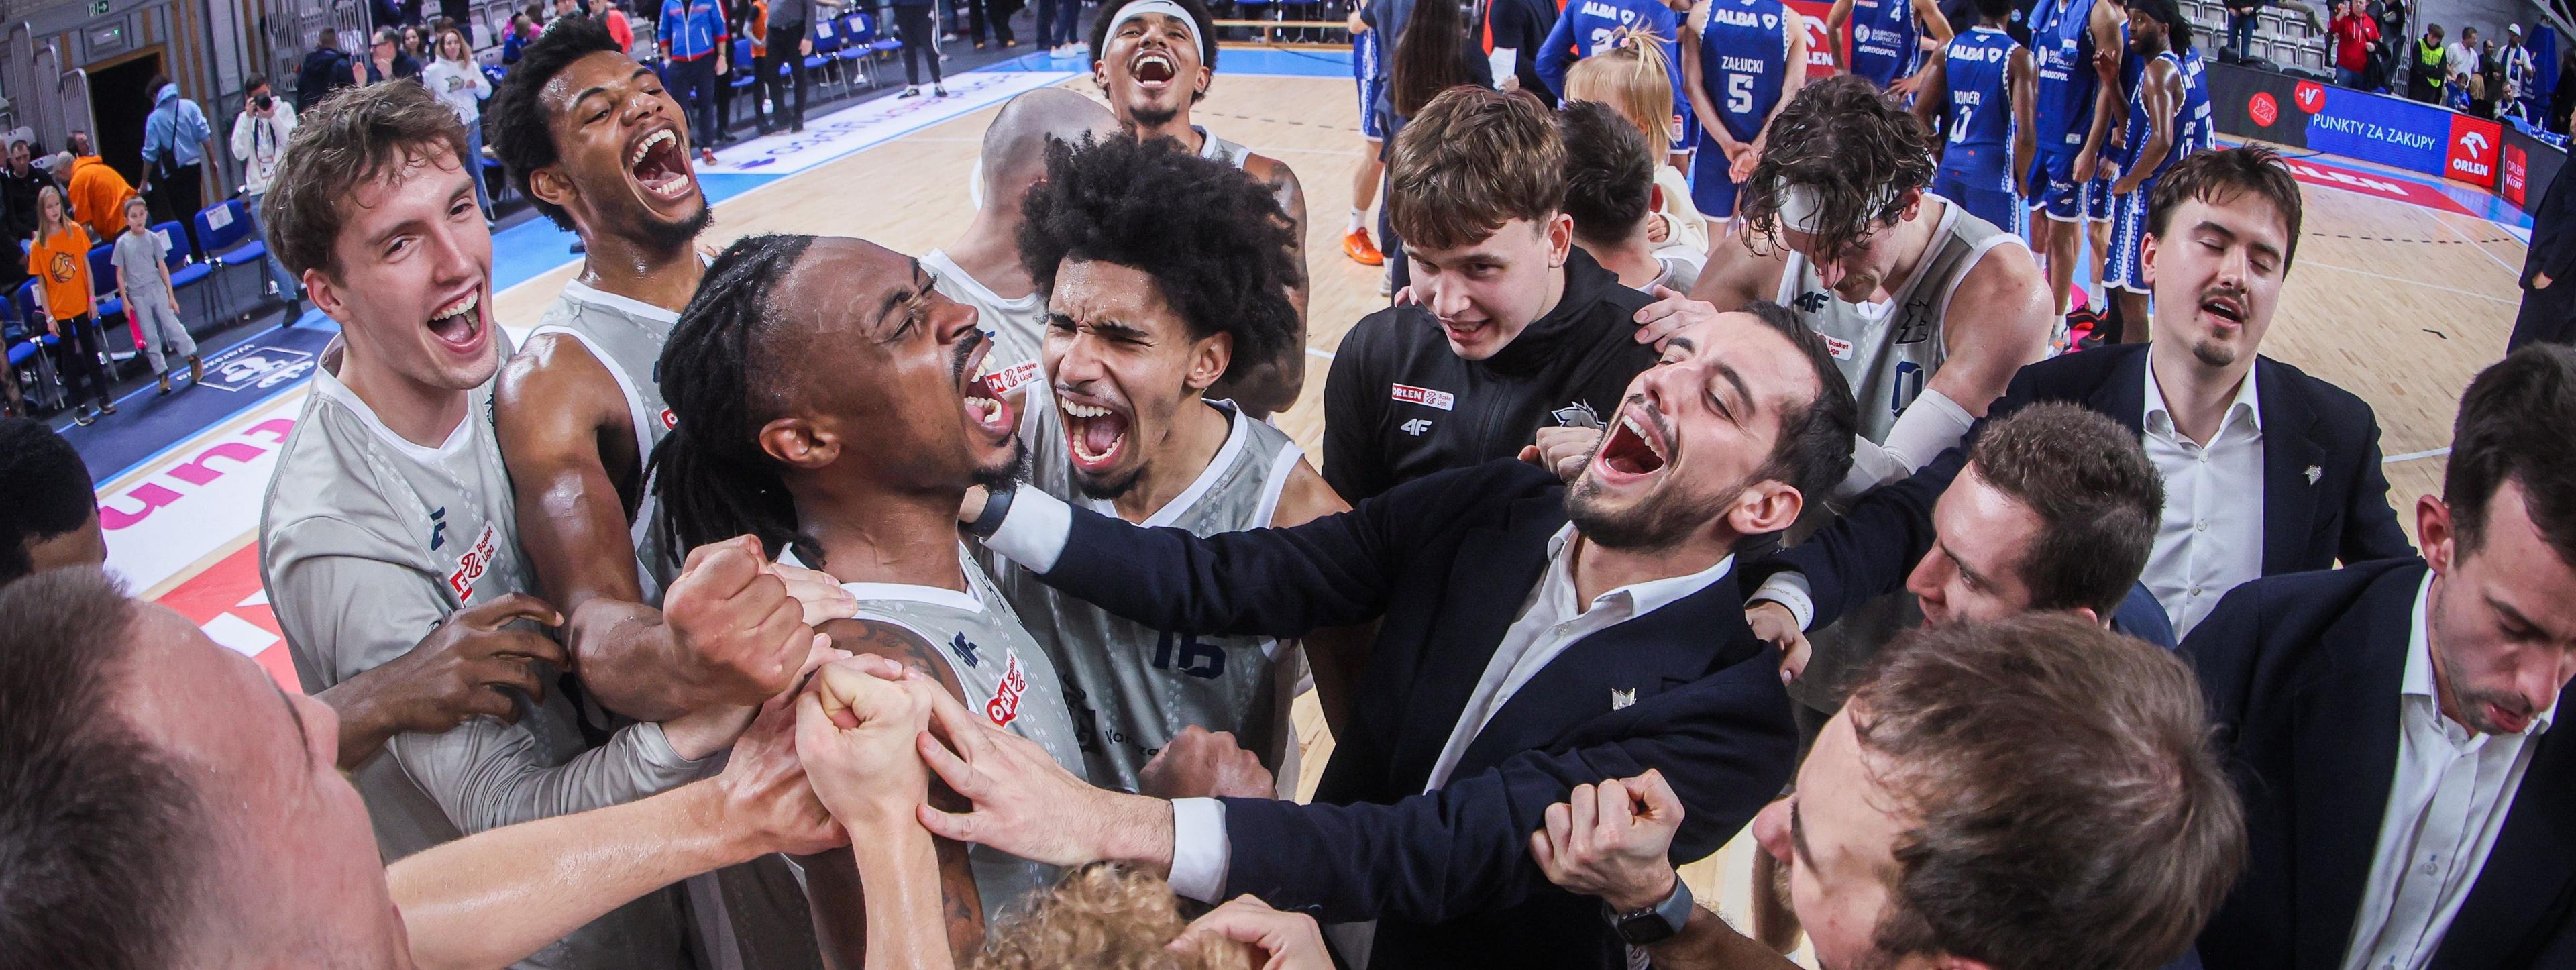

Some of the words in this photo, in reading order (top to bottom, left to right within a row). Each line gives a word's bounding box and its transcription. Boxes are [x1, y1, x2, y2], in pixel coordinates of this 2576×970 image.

[1581, 1, 1617, 21] ALBA
[1714, 9, 1759, 28] ALBA
[1890, 7, 1901, 22] 4
[1806, 51, 1835, 66] LEN
[1949, 44, 1984, 61] ALBA
[1721, 56, 1764, 74] ZAŁUCKI
[1727, 73, 1754, 114] 5
[2313, 113, 2366, 136] PUNKTY
[2367, 123, 2383, 140] ZA
[2386, 128, 2436, 151] ZAKUPY
[2453, 158, 2489, 176] ORLEN
[2506, 160, 2524, 177] ORLEN
[1794, 291, 1830, 314] 4F
[1828, 339, 1849, 351] Basket
[1400, 418, 1433, 437] 4F
